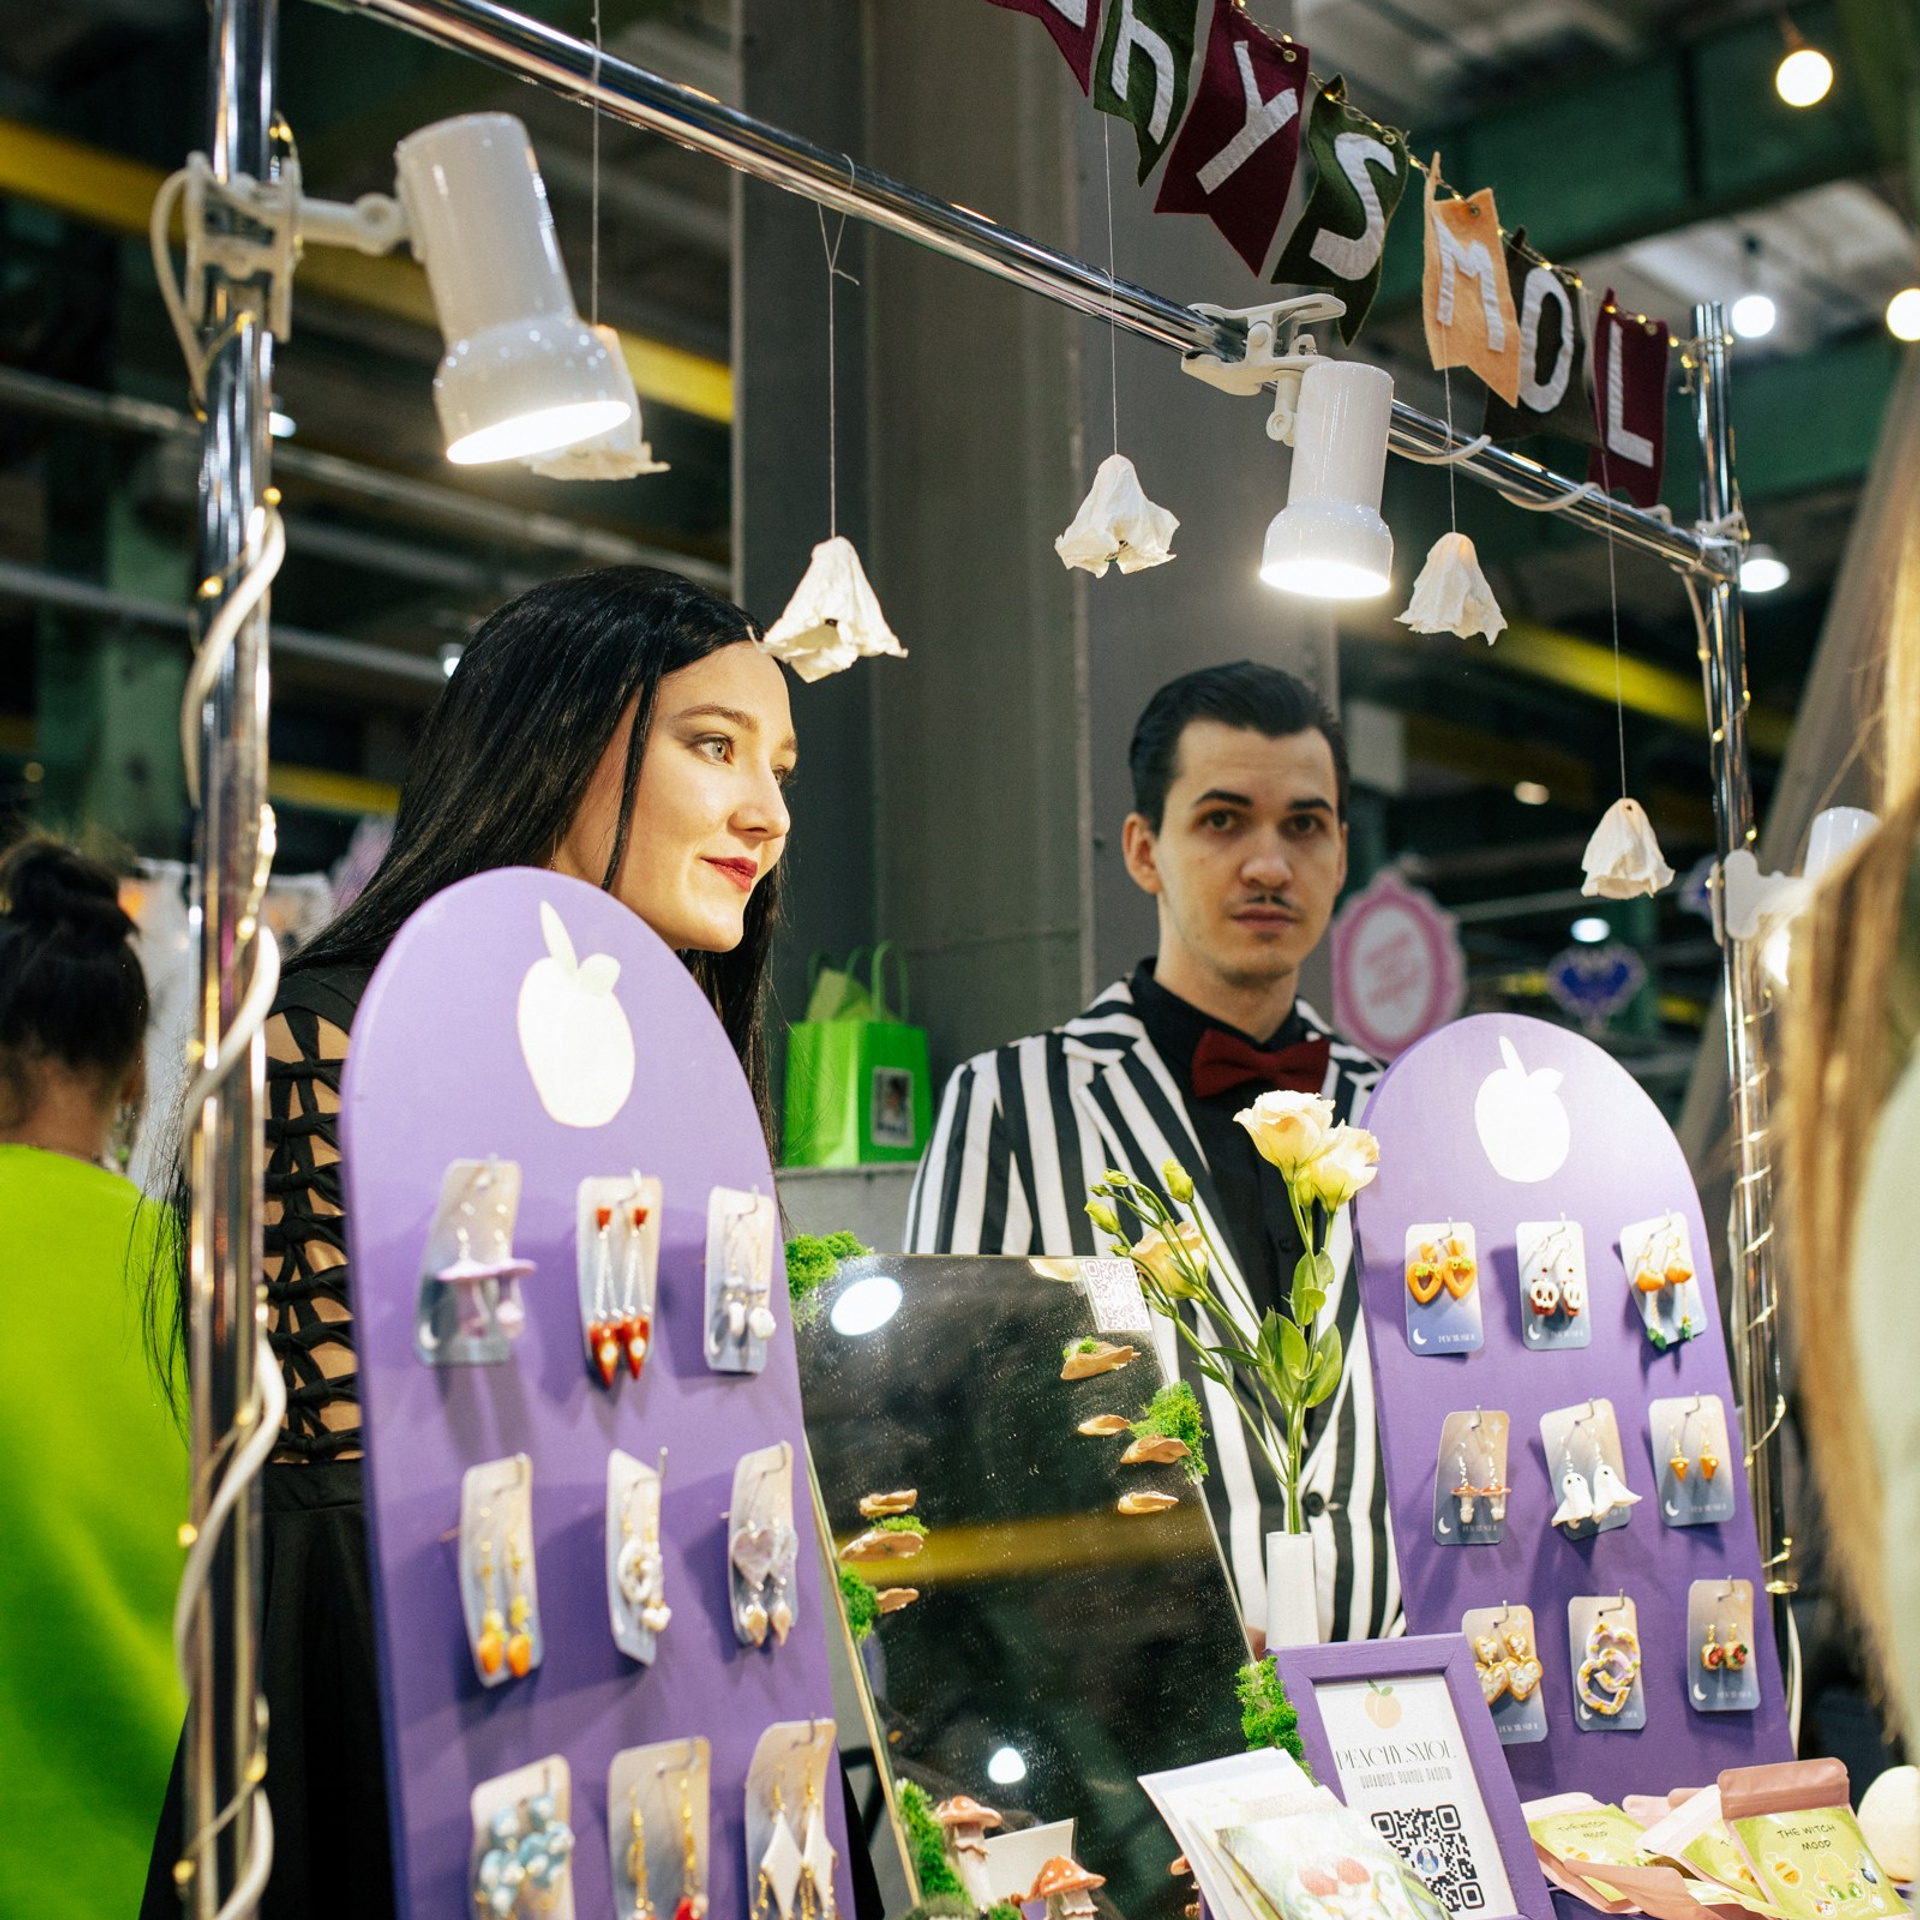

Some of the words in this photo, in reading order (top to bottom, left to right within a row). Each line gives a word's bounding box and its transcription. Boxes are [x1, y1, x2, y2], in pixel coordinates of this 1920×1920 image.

[1777, 1828, 1801, 1838] THE
[1802, 1824, 1836, 1834] WITCH
[1802, 1840, 1832, 1851] MOOD
